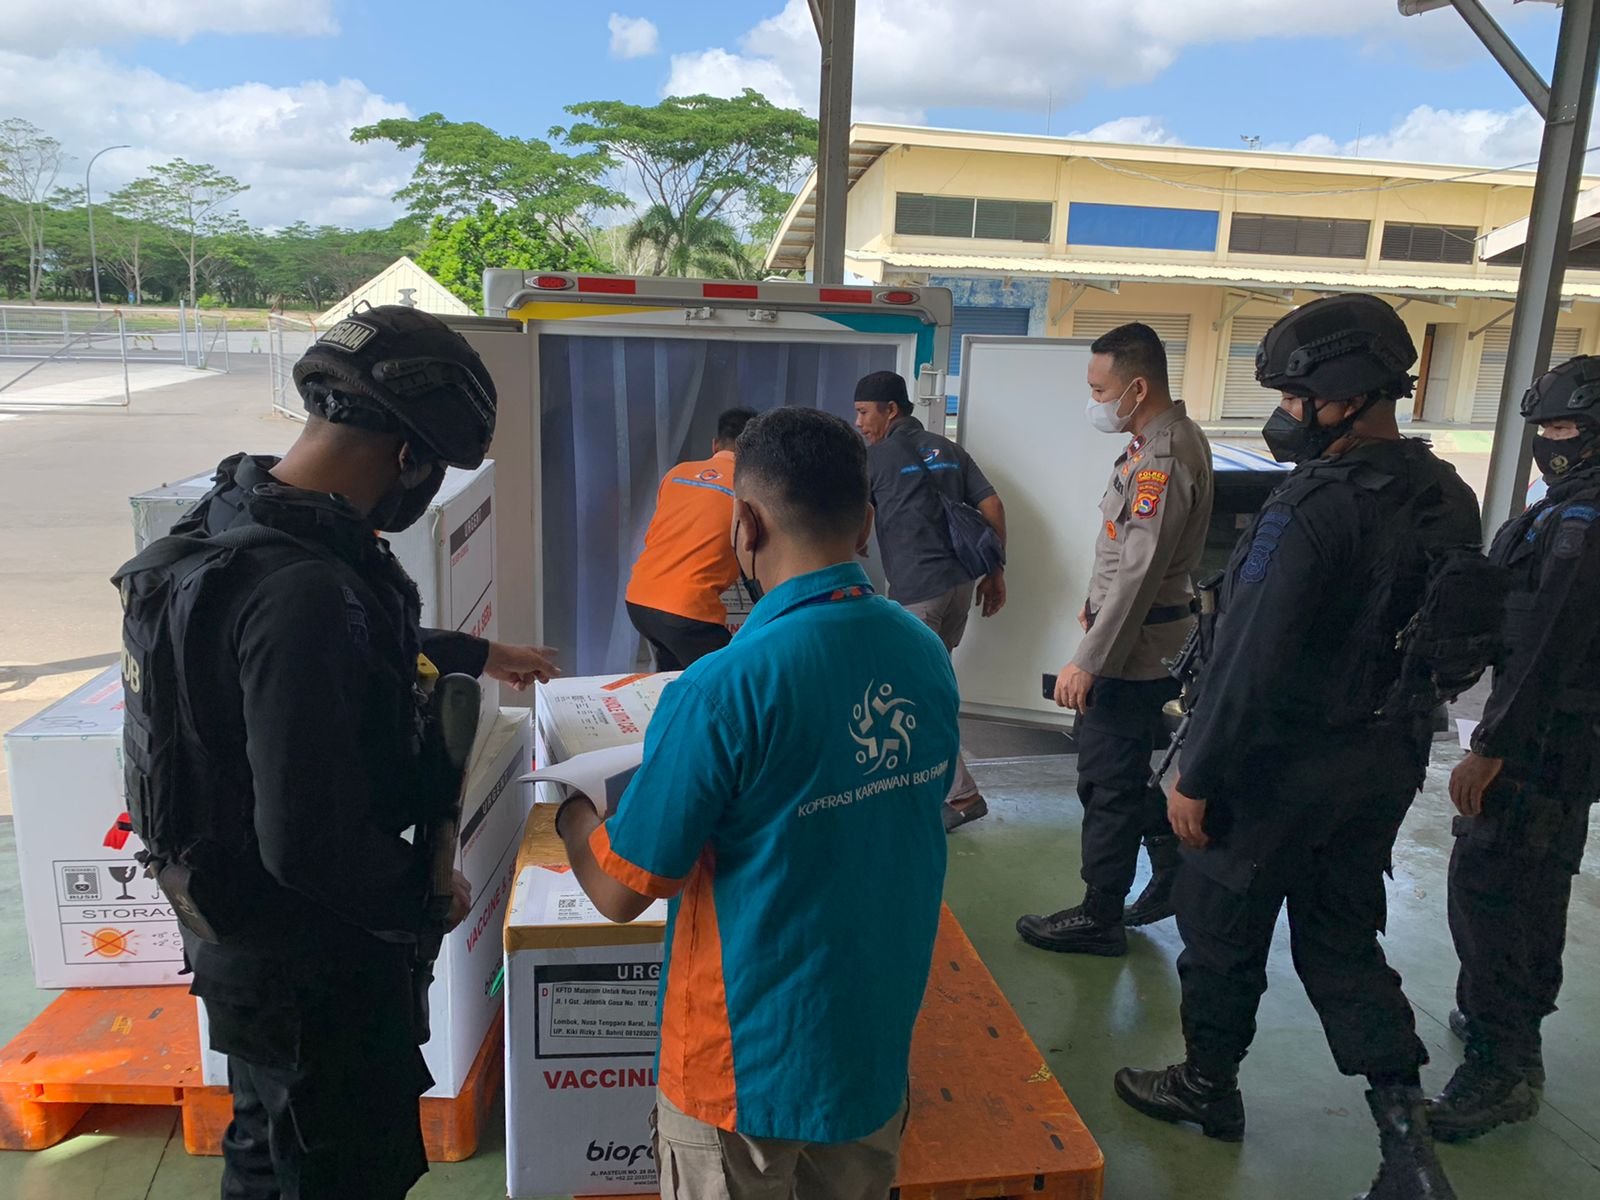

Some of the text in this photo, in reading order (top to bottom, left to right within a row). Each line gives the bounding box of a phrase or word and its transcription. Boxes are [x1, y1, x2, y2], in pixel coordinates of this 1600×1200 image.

[123, 647, 140, 693] OB
[798, 791, 853, 817] KOPERASI
[855, 773, 910, 801] KARYAWAN
[912, 769, 930, 785] BIO
[466, 887, 500, 953] VACCINE
[617, 964, 660, 980] URG
[638, 989, 657, 997] Tengg
[599, 1019, 626, 1027] Tenggara
[580, 1029, 595, 1037] Rizky
